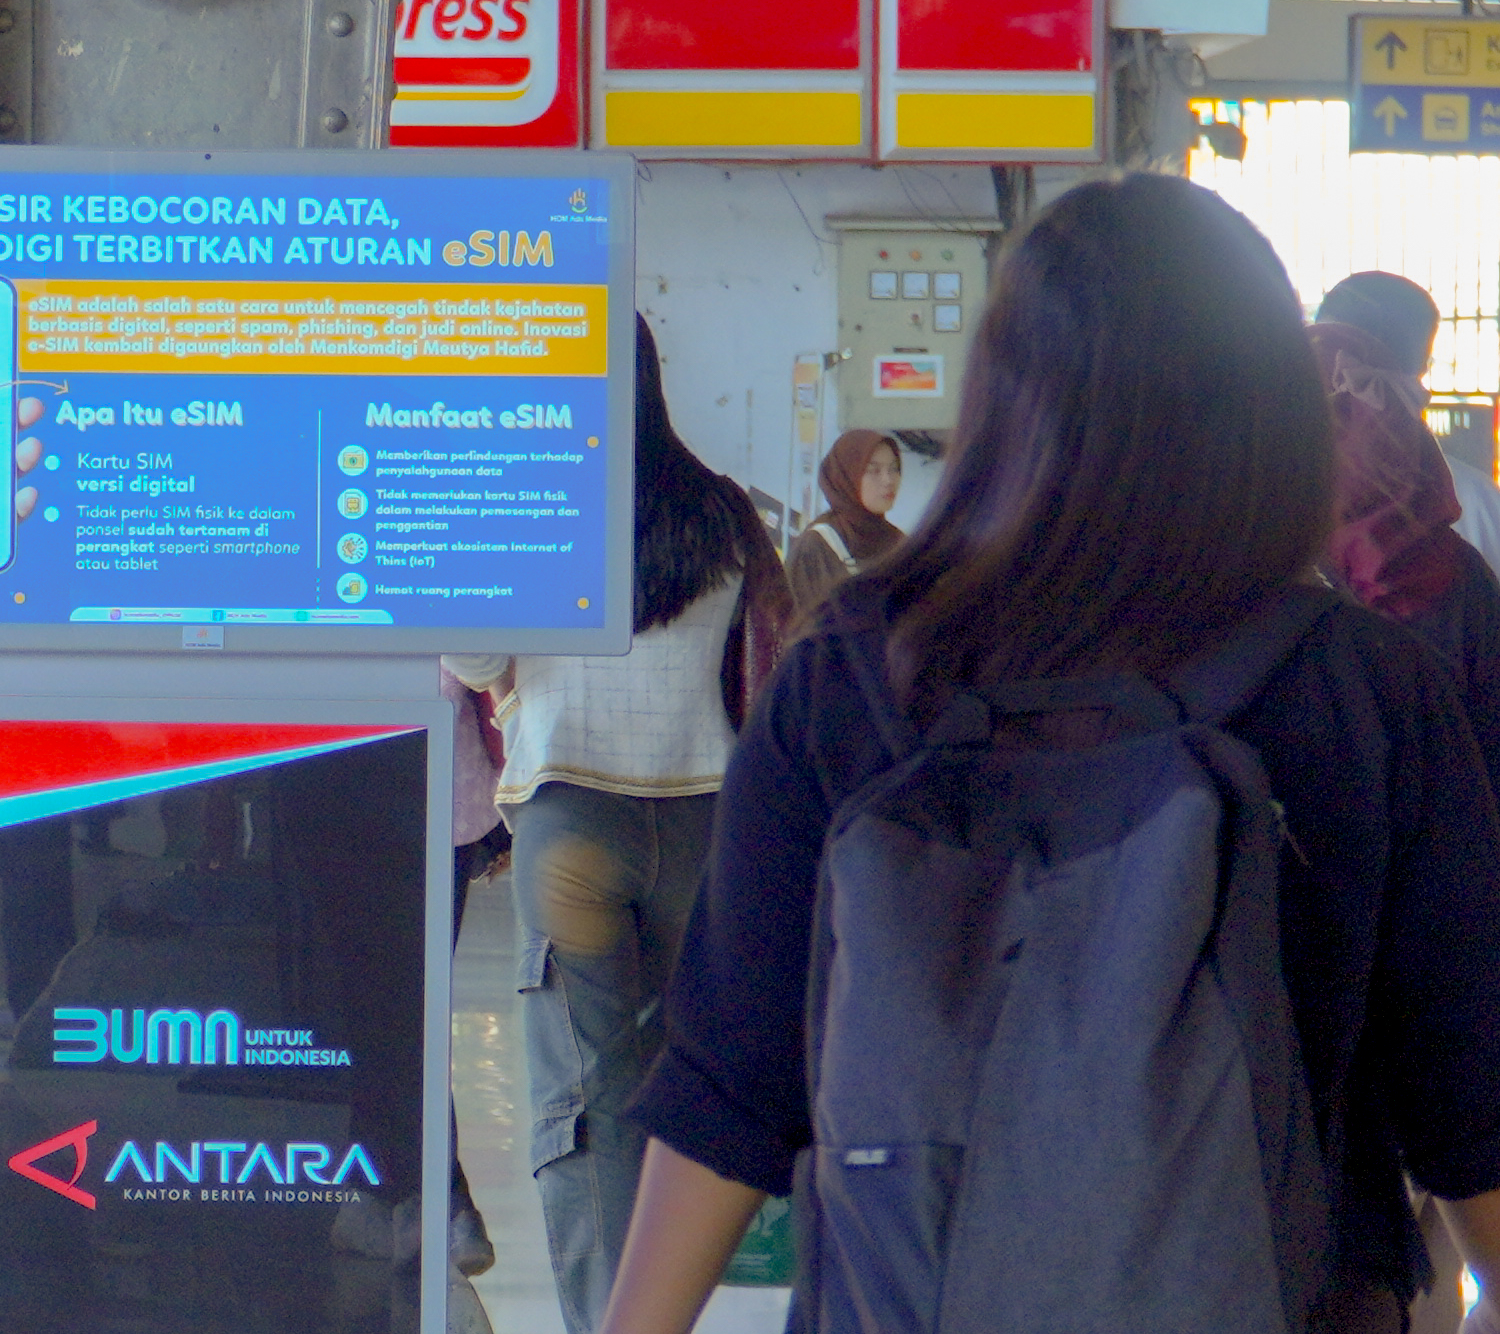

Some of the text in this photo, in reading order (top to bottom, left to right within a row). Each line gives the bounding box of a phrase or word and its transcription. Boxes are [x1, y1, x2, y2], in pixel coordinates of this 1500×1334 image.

[63, 194, 287, 226] KEBOCORAN
[299, 197, 400, 230] DATA,
[73, 234, 273, 265] TERBITKAN
[283, 236, 432, 266] ATURAN
[442, 229, 555, 268] eSIM
[28, 297, 585, 320] eSIM adalah salah satu cara untuk mencegah tindak kejahatan
[28, 318, 588, 339] berbasis digital, seperti spam, phishing, dan judi online. Inovasi
[28, 337, 549, 359] e-SIM kembali digaungkan oleh Menkomdigi Meutya Hafid.
[55, 400, 244, 431] Apa Itu eSIM
[365, 401, 573, 430] Manfaat eSIM
[77, 453, 173, 470] Kartu SIM
[375, 450, 584, 465] Memberikan perlindungan terhadap
[375, 465, 503, 478] penyalahgunaan data
[76, 475, 195, 497] versi digital
[375, 489, 408, 500] Tidak
[485, 490, 515, 501] kartu
[518, 490, 541, 501] SIM
[543, 490, 568, 502] fisik
[76, 505, 295, 523] Tidak perlu SIM fisik ke dalam
[375, 505, 412, 515] dalam
[415, 505, 478, 516] melakukan
[557, 507, 580, 517] dan
[76, 523, 269, 540] ponsel sudah tertanam di
[375, 521, 449, 533] penggantian
[76, 540, 300, 558] perangkat seperti smartphone
[560, 541, 574, 553] of
[76, 558, 159, 571] atau tablet
[375, 584, 513, 599] Hemat ruang perangkat
[53, 1007, 239, 1066] BUMN
[245, 1030, 313, 1047] UNTUK
[245, 1049, 352, 1067] INDONESIA
[105, 1140, 382, 1186] ANTARA
[123, 1188, 362, 1204] KANTOR BERITA INDONESIA
